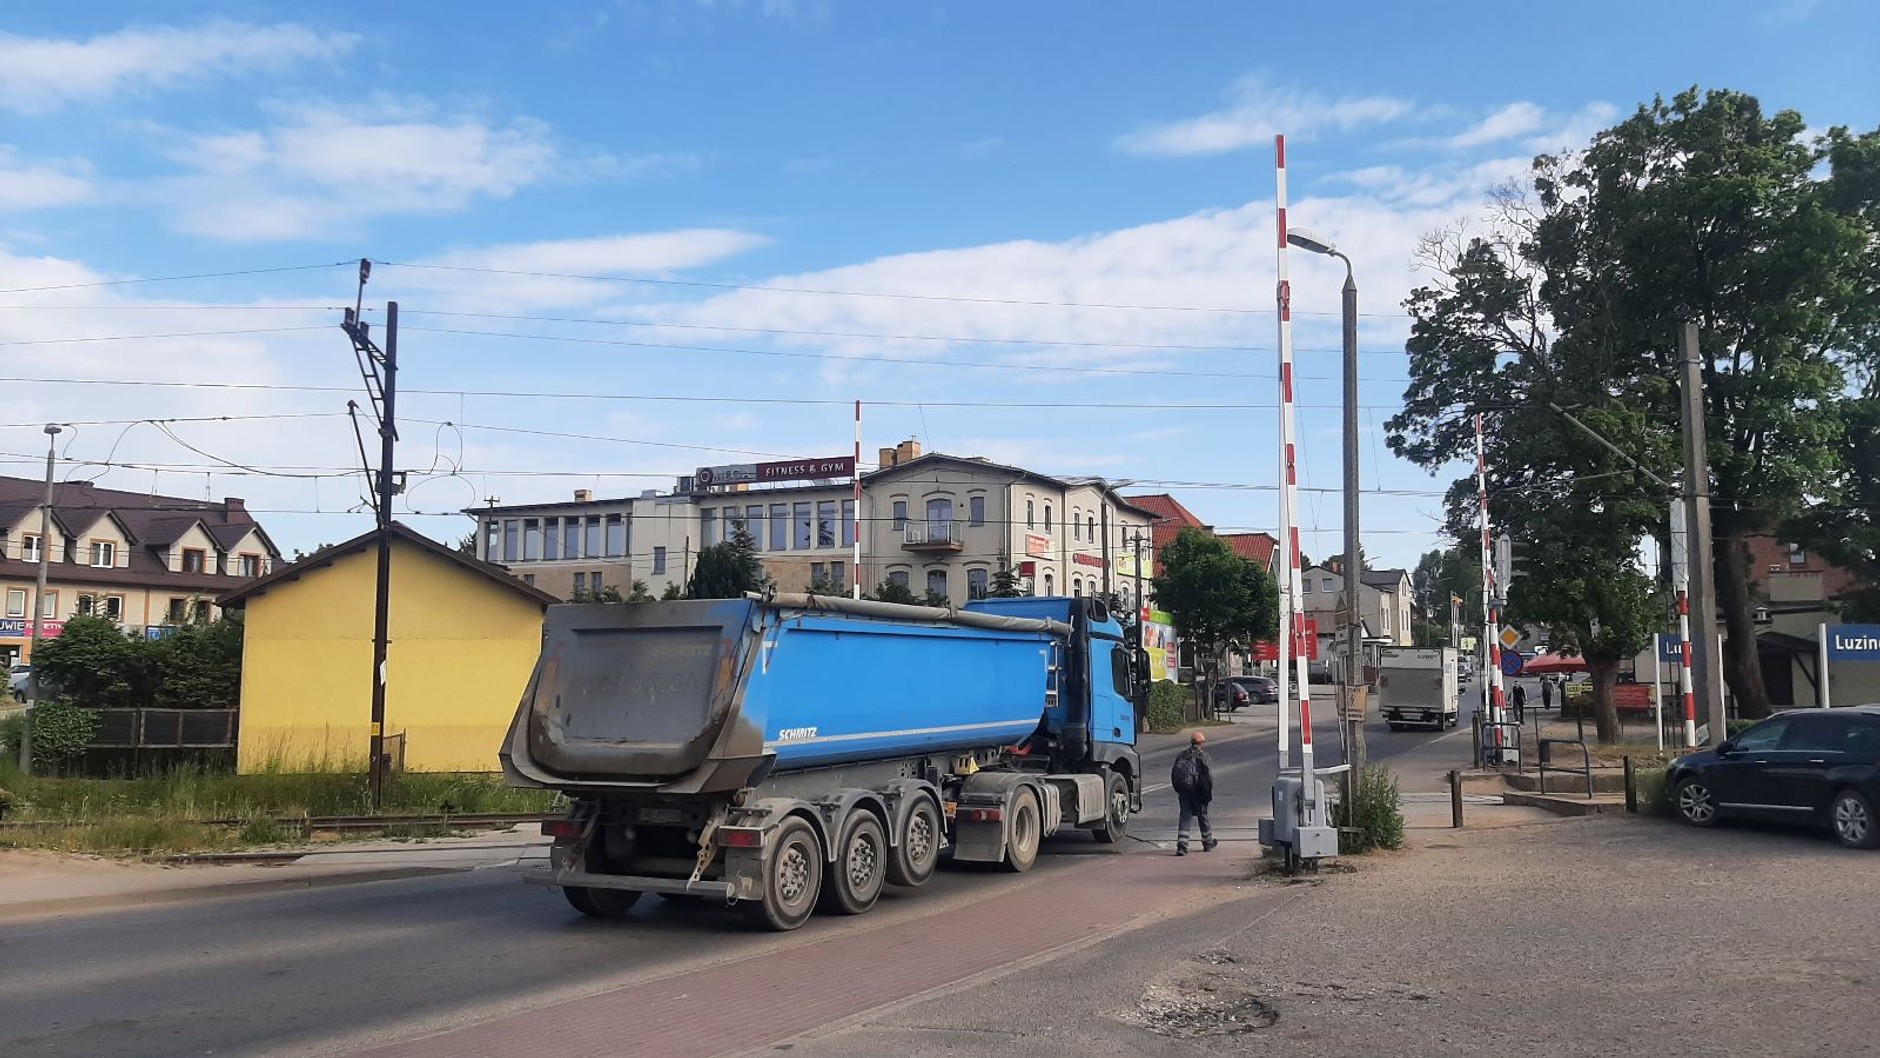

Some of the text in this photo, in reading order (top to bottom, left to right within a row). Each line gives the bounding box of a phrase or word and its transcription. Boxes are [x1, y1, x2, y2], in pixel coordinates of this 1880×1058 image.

[766, 465, 805, 477] FITNESS
[809, 464, 817, 473] &
[821, 462, 844, 472] GYM
[1835, 634, 1880, 650] Luzin
[778, 727, 817, 741] SCHMITZ
